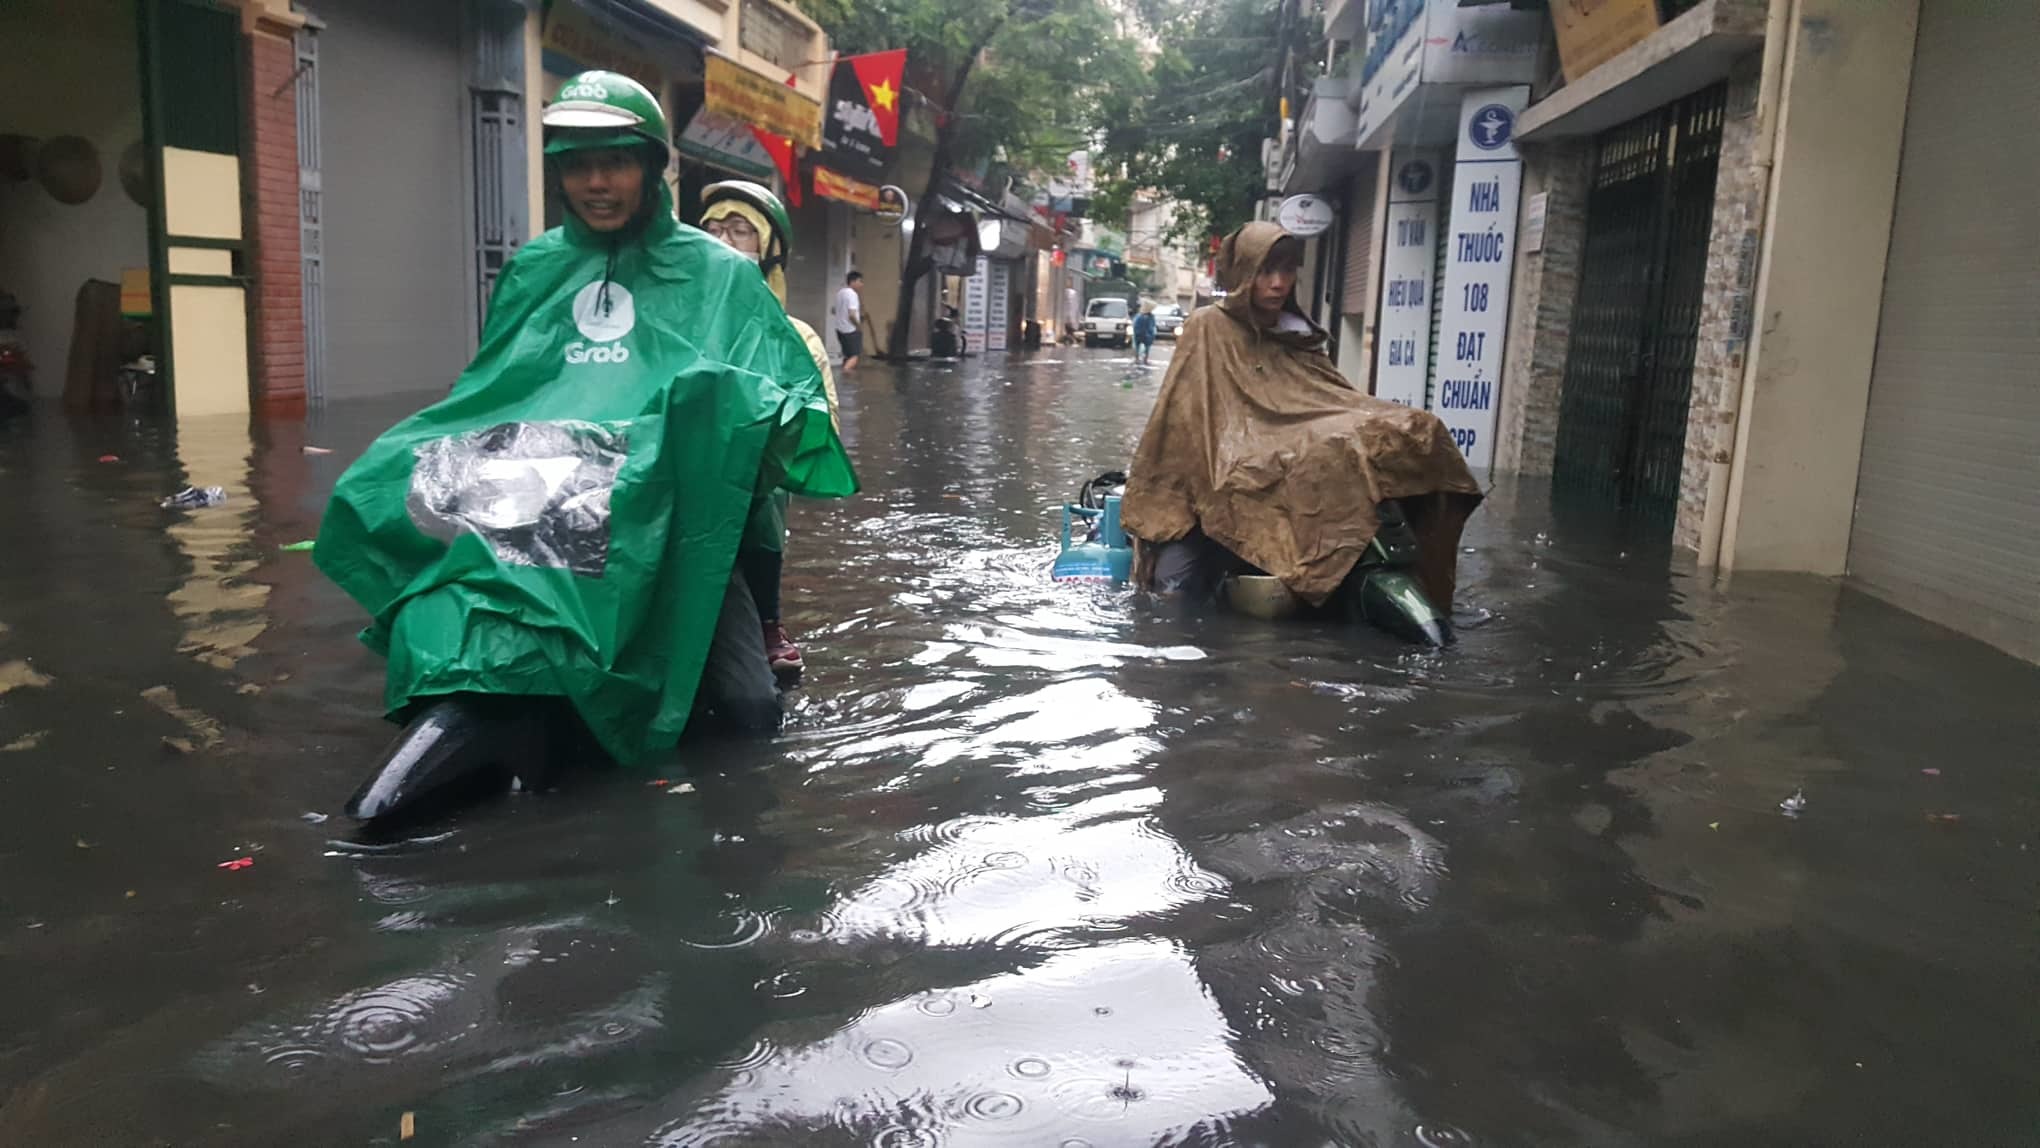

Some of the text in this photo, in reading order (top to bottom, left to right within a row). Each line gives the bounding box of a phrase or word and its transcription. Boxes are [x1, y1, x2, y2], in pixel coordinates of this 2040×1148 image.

[561, 83, 608, 100] Grab
[1457, 221, 1504, 263] THUỐC
[1463, 283, 1489, 313] 108
[565, 341, 629, 364] Grab
[1456, 331, 1486, 368] ĐẠT
[1441, 368, 1492, 410] CHUẨN
